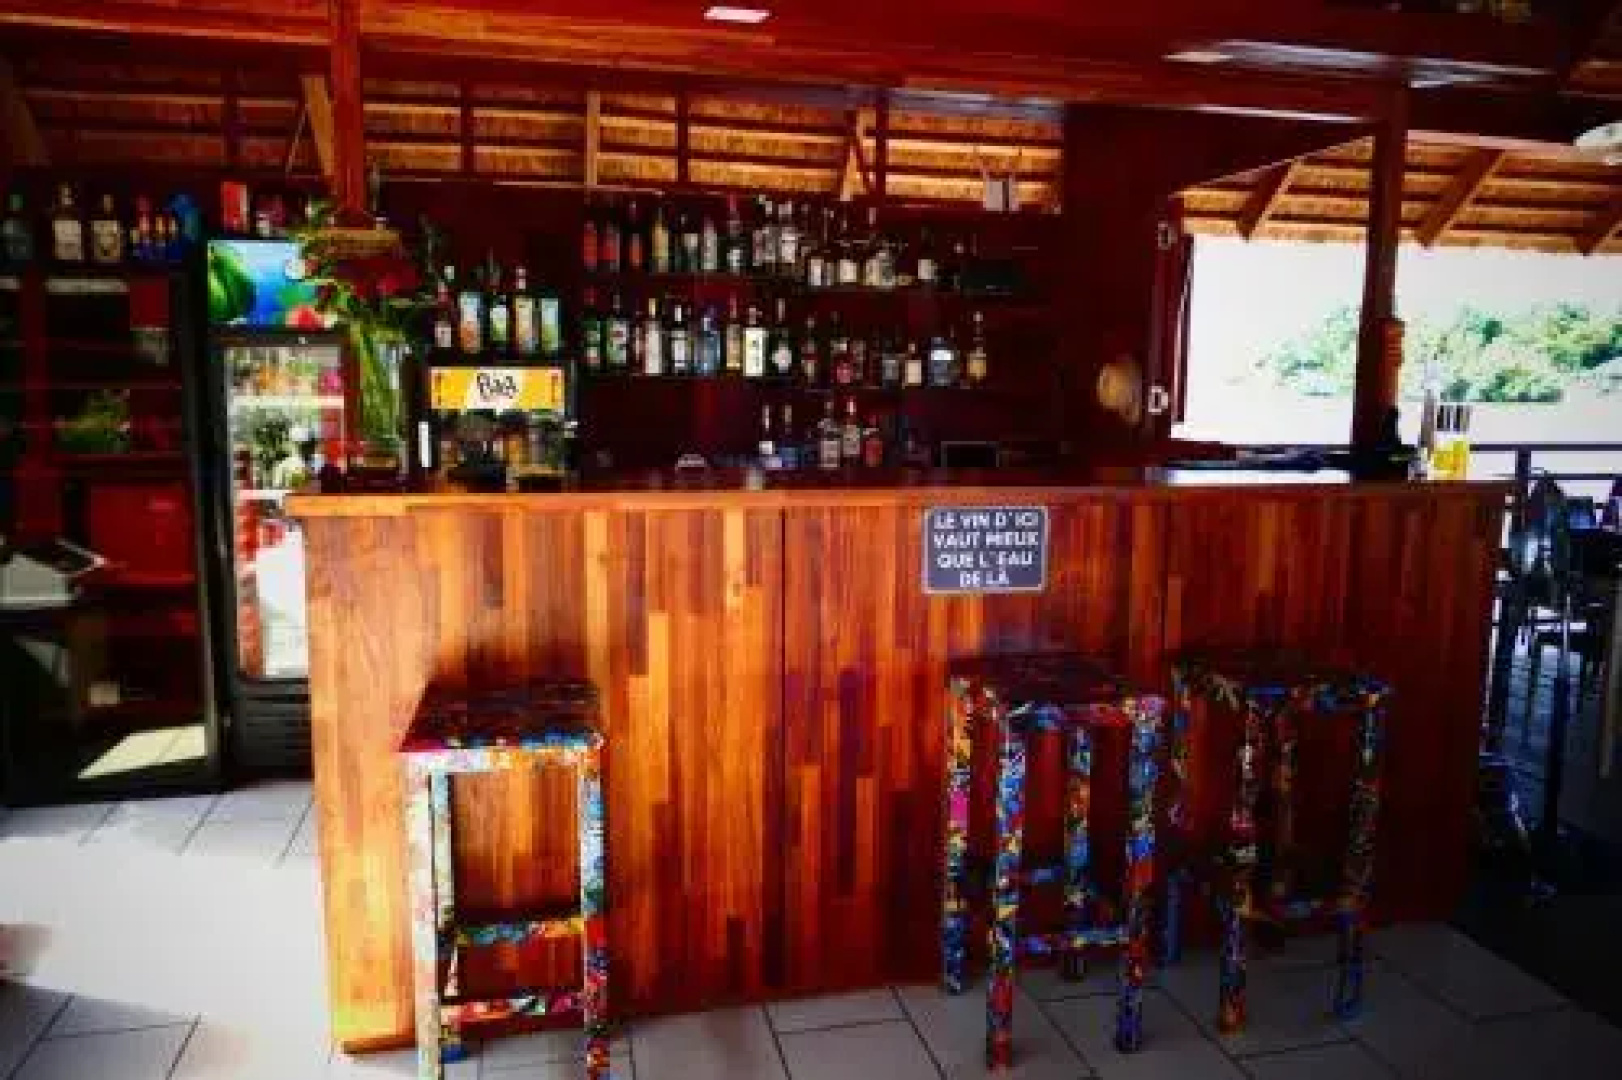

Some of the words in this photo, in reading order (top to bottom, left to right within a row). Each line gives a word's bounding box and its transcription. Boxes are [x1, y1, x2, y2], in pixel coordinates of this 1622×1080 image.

[934, 512, 955, 529] LE
[960, 511, 990, 527] VIN
[934, 532, 980, 548] VAUT
[985, 532, 1039, 547] MIEUX
[937, 551, 974, 568] QUE
[959, 570, 981, 587] DE
